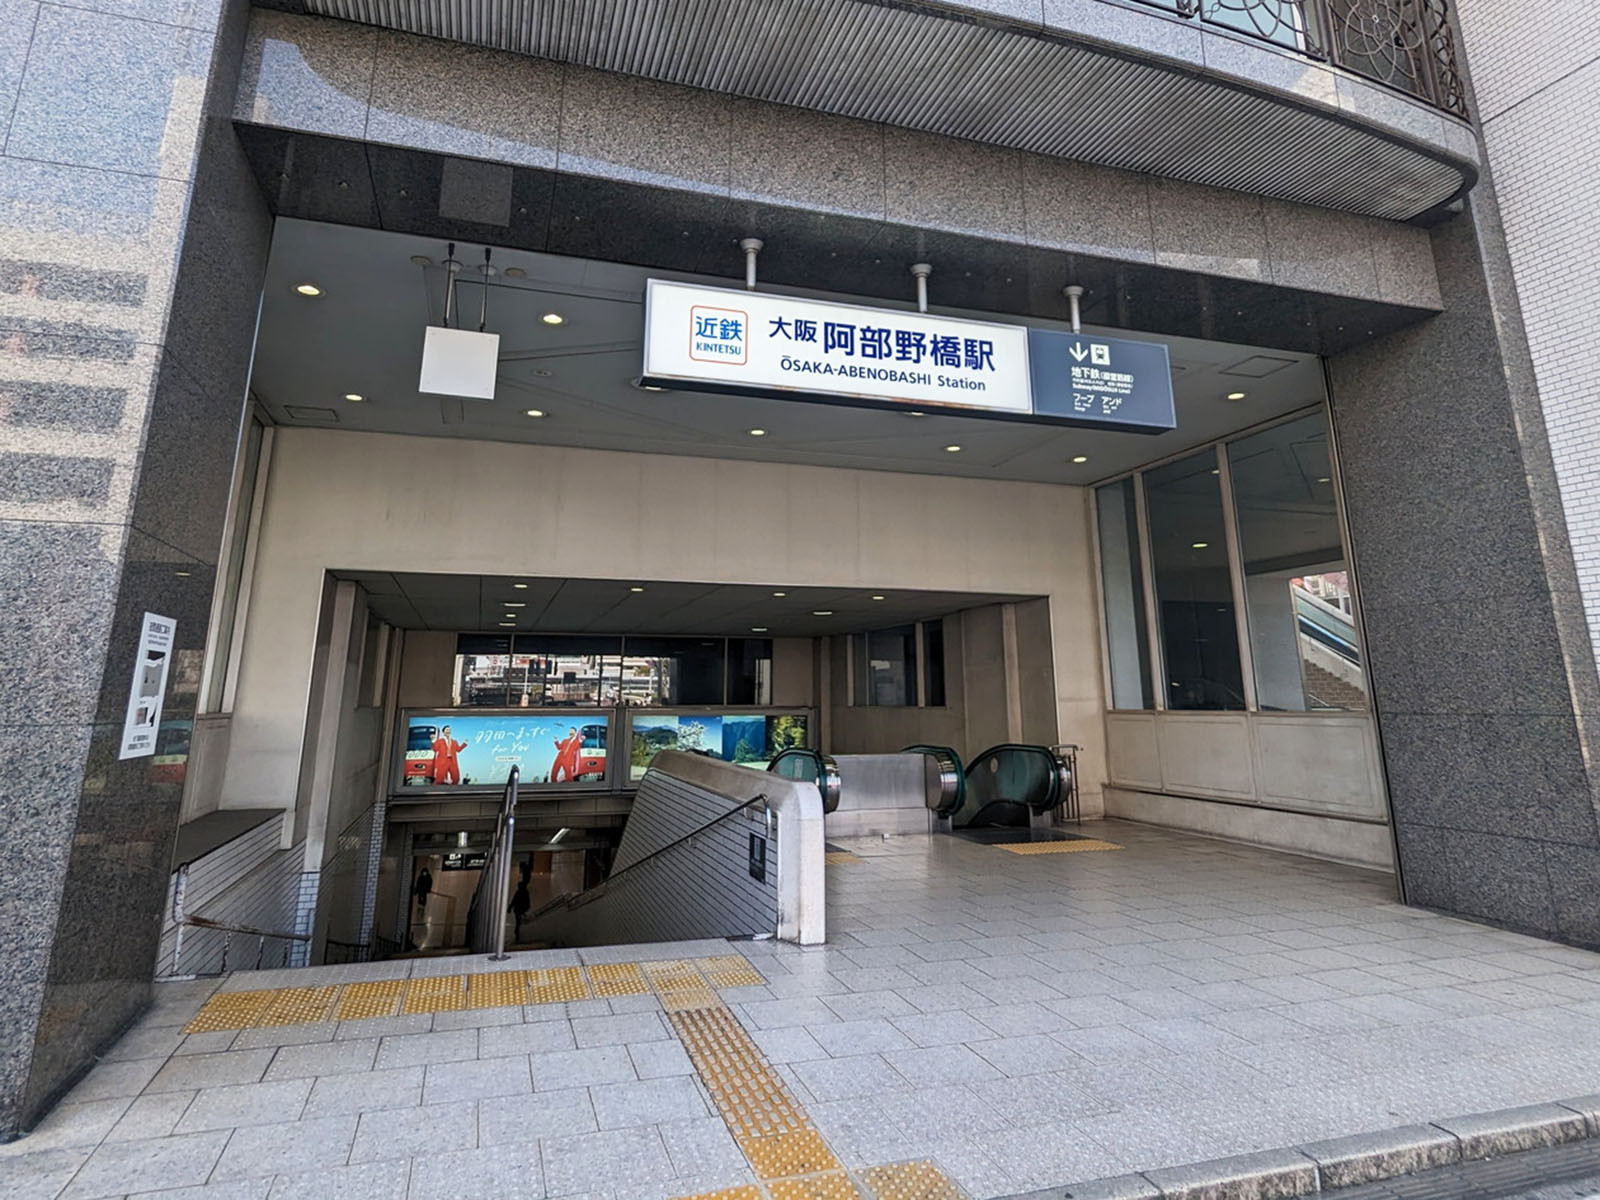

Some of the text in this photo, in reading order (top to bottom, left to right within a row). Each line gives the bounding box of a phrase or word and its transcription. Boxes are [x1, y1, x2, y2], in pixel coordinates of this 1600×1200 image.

[695, 316, 743, 341] 近鉄
[696, 342, 742, 355] KINTETSU
[780, 355, 987, 391] ŌSAKA-ABENOBASHI Station
